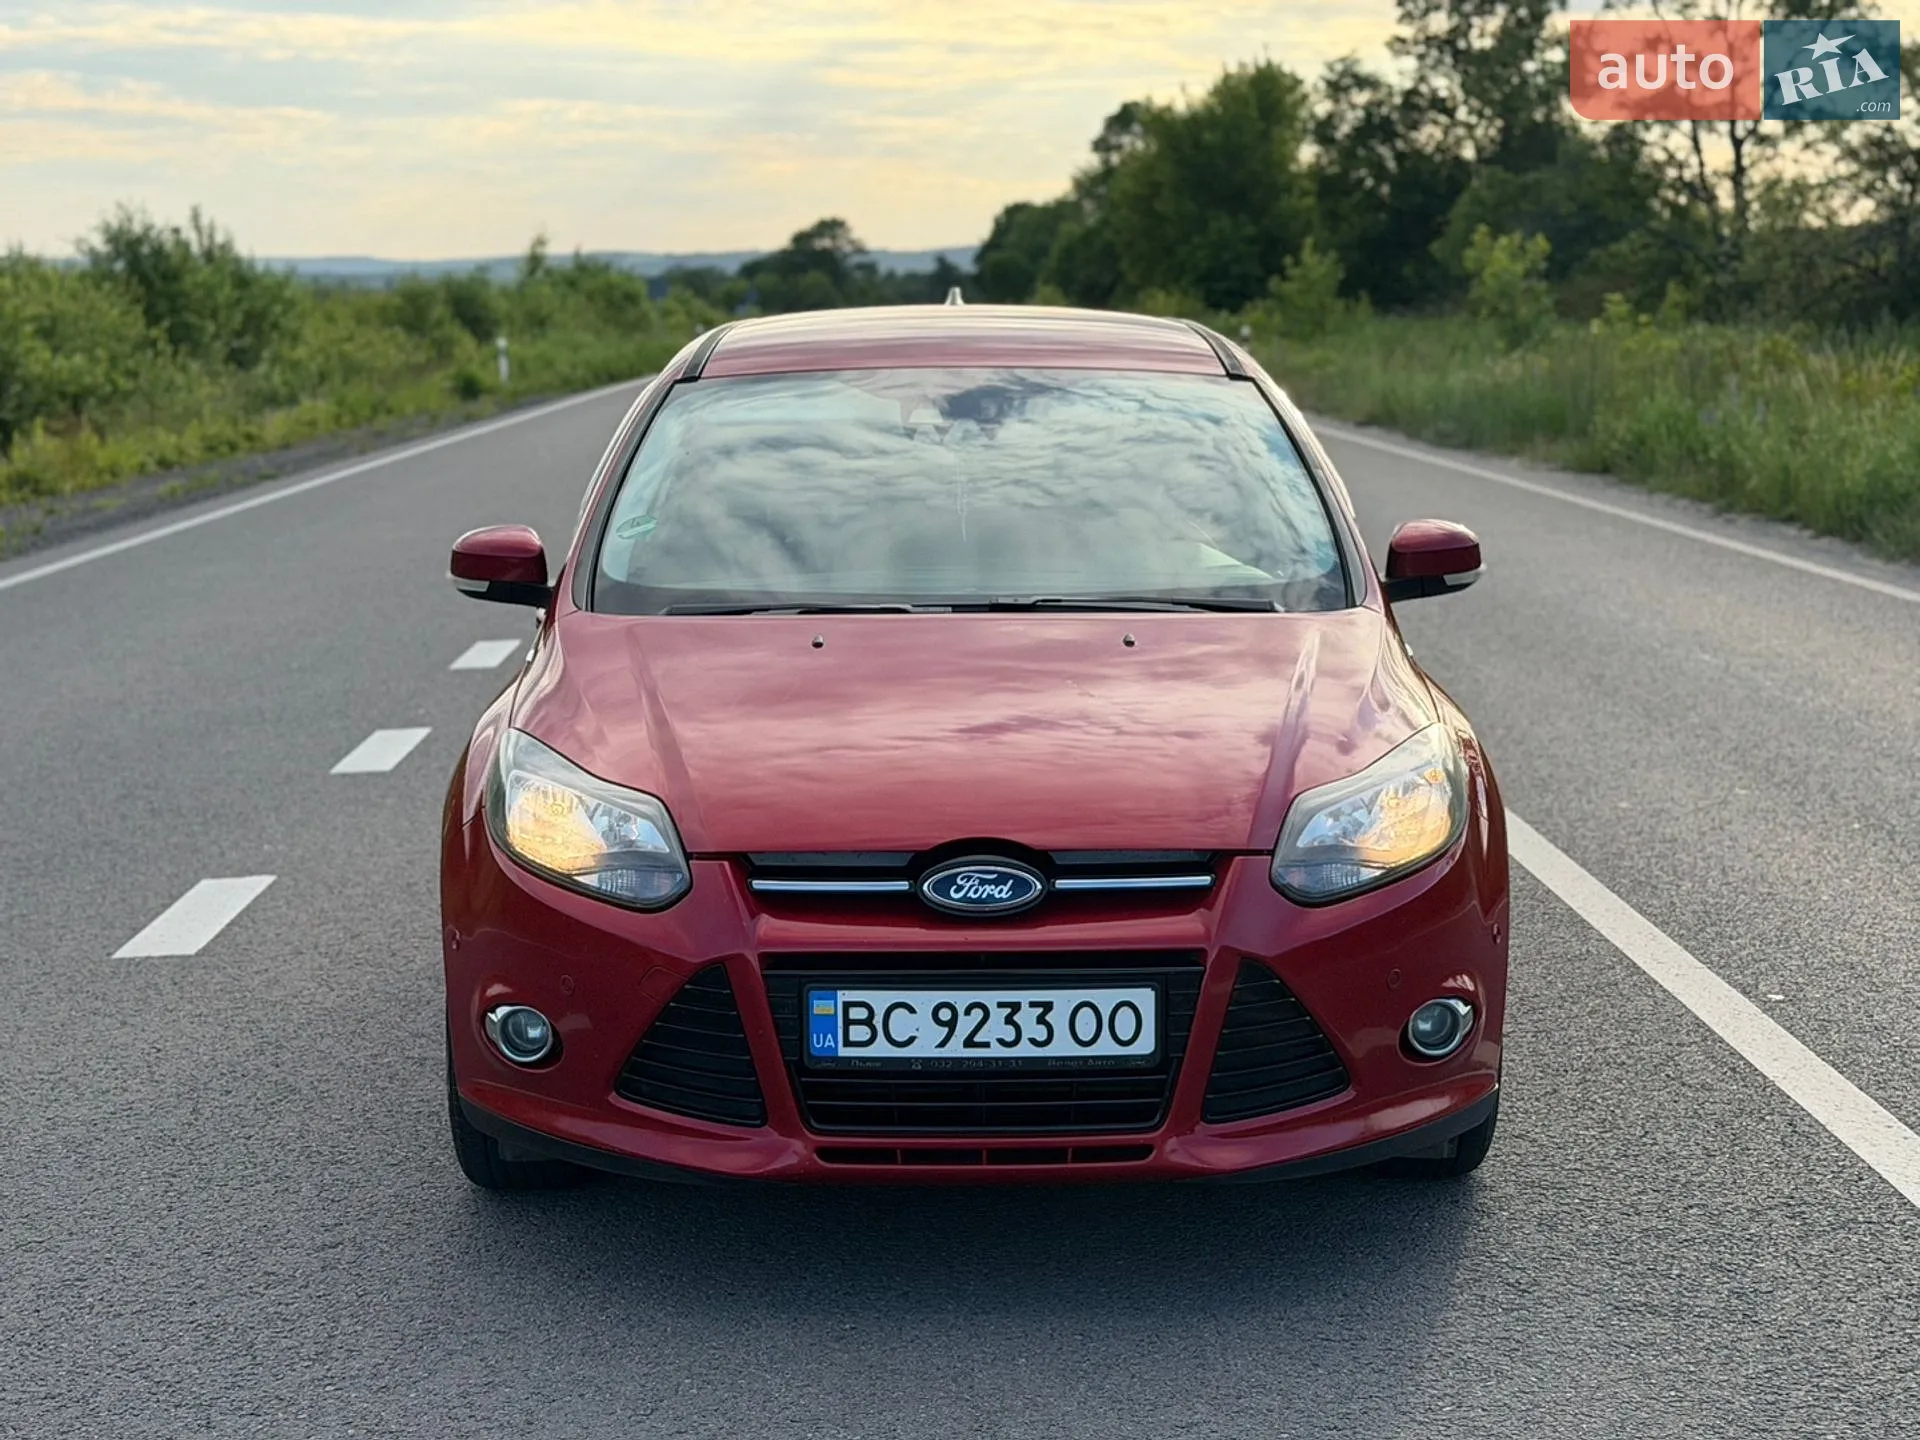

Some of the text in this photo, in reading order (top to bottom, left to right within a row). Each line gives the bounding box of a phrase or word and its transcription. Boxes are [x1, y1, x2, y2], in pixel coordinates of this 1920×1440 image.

[949, 872, 1014, 899] Ford
[842, 1000, 919, 1049] BC
[931, 1000, 1055, 1049] 9233
[812, 1033, 836, 1049] UA
